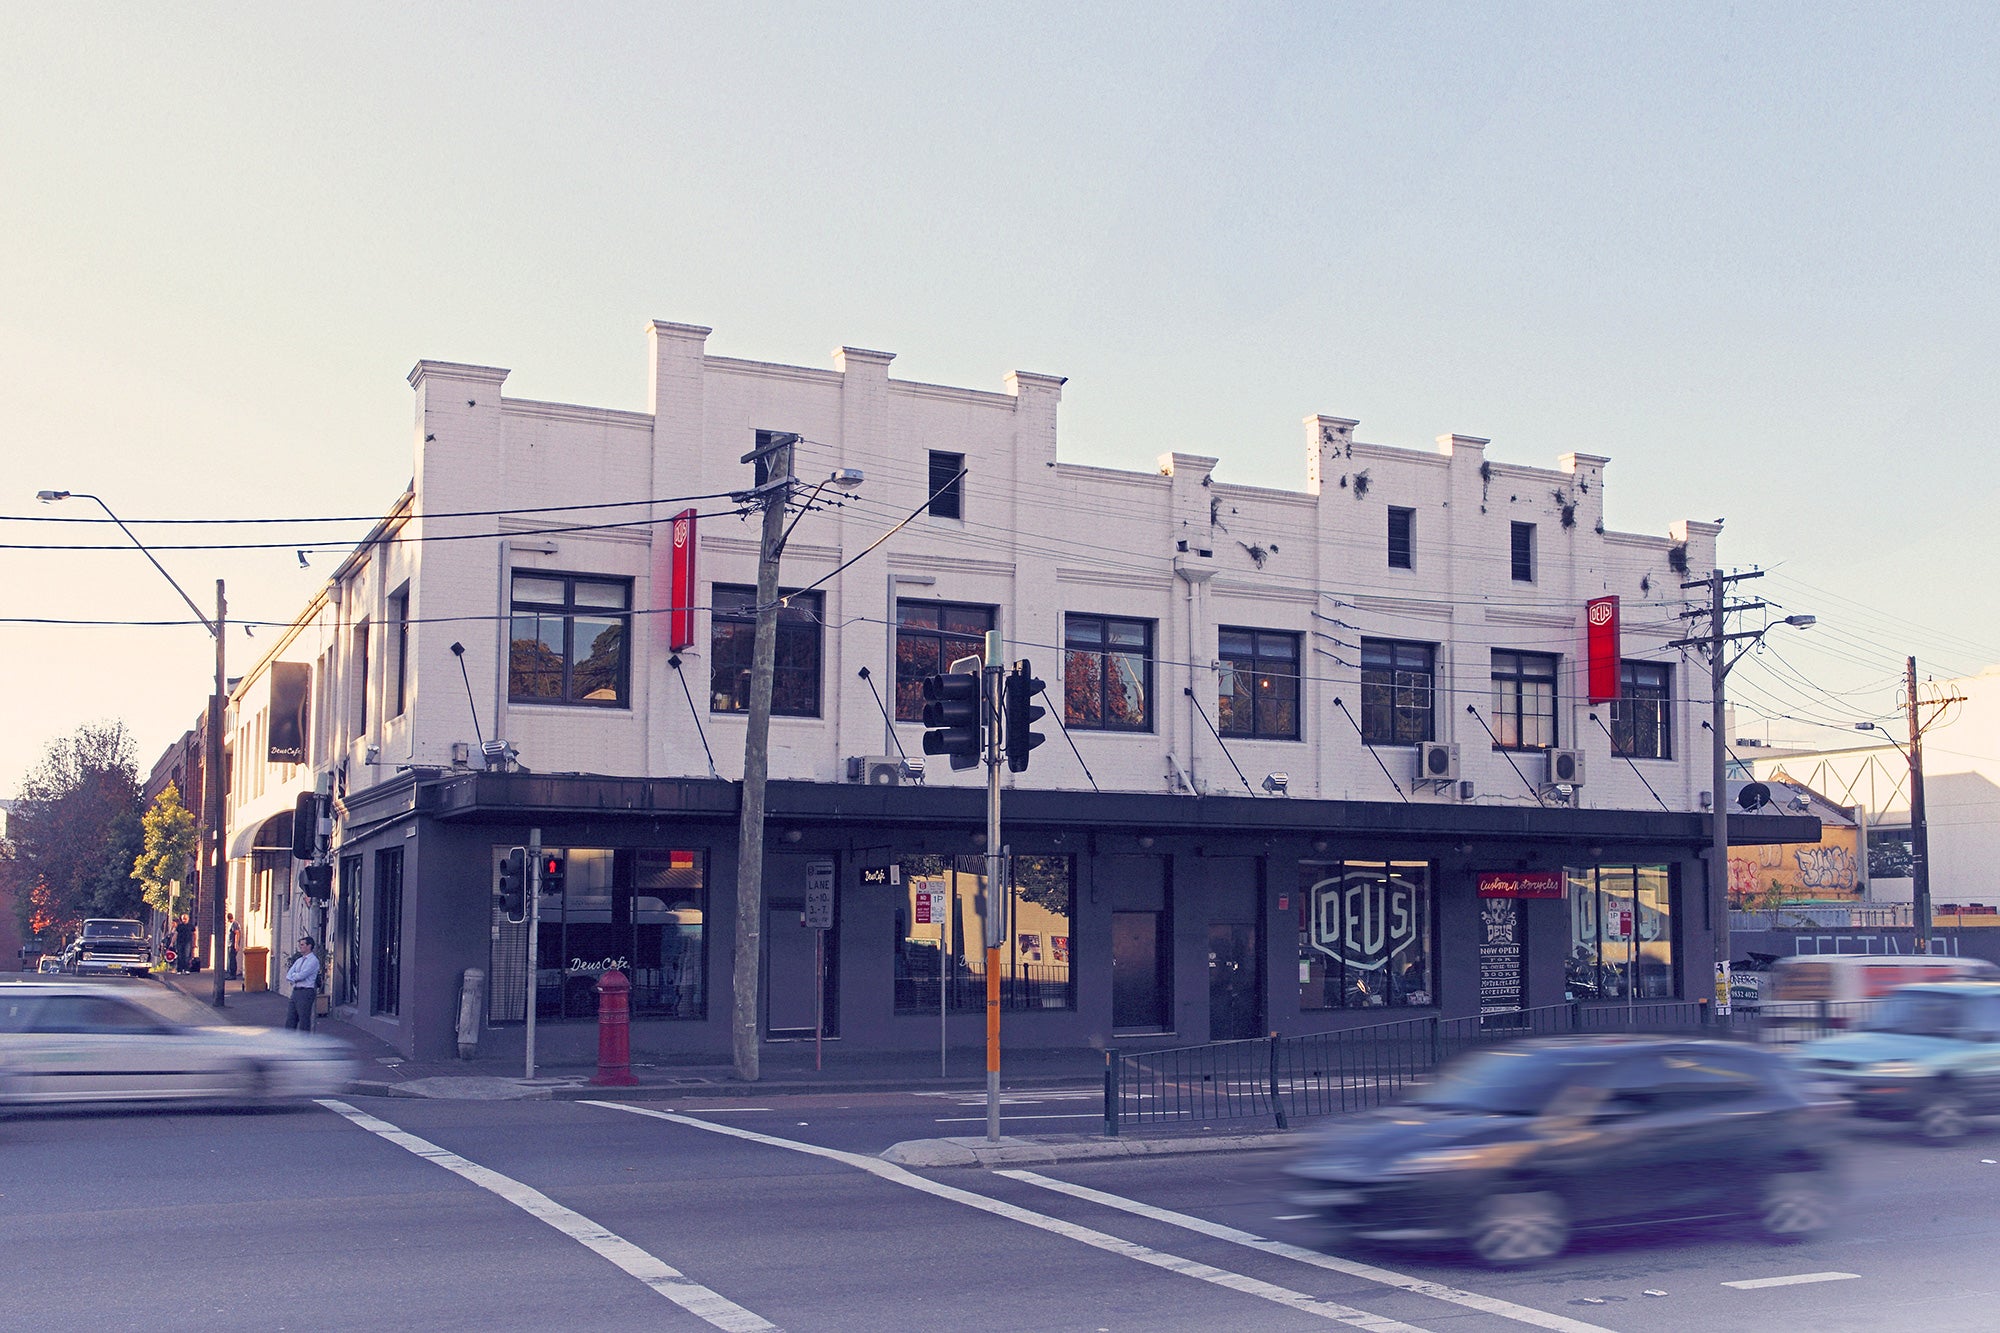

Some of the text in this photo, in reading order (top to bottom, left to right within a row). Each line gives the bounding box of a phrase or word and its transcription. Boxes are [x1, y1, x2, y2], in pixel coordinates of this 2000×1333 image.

[1592, 604, 1610, 621] DEUS
[808, 880, 830, 890] LANE
[1480, 877, 1509, 892] Custom
[933, 895, 944, 903] 1P
[1320, 883, 1408, 955] DEUS
[1487, 924, 1513, 942] DEUS
[1480, 947, 1498, 955] NOW
[570, 957, 601, 971] Deus
